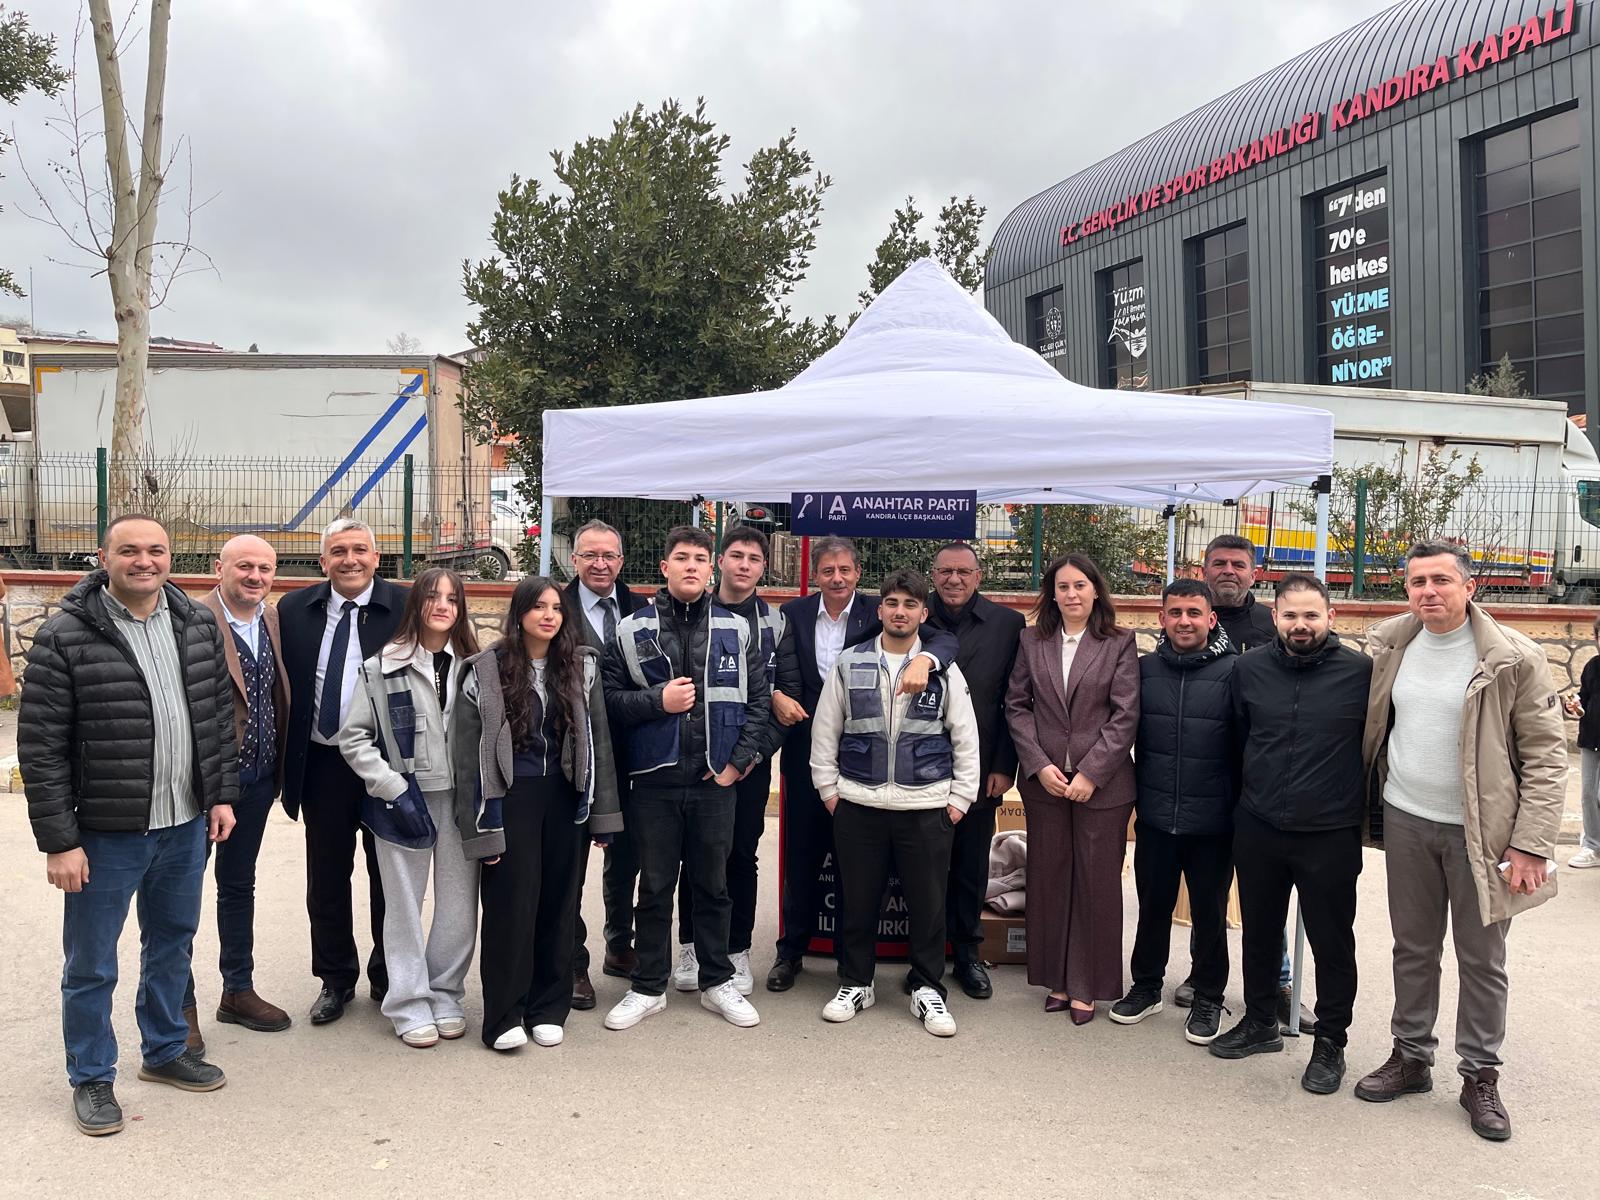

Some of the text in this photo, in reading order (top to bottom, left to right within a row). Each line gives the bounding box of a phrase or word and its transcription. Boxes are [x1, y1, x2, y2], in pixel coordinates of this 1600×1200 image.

[1059, 0, 1576, 246] T.C. GENÇLİK VE SPOR BAKANLIĞI KANDIRA KAPALI
[1330, 256, 1388, 286] herkes
[1331, 288, 1390, 318] YÜZME
[829, 494, 847, 515] A
[852, 496, 970, 511] ANAHTAR PARTİ
[897, 512, 913, 521] İLÇE
[913, 513, 955, 522] BAŞKANLIĞI
